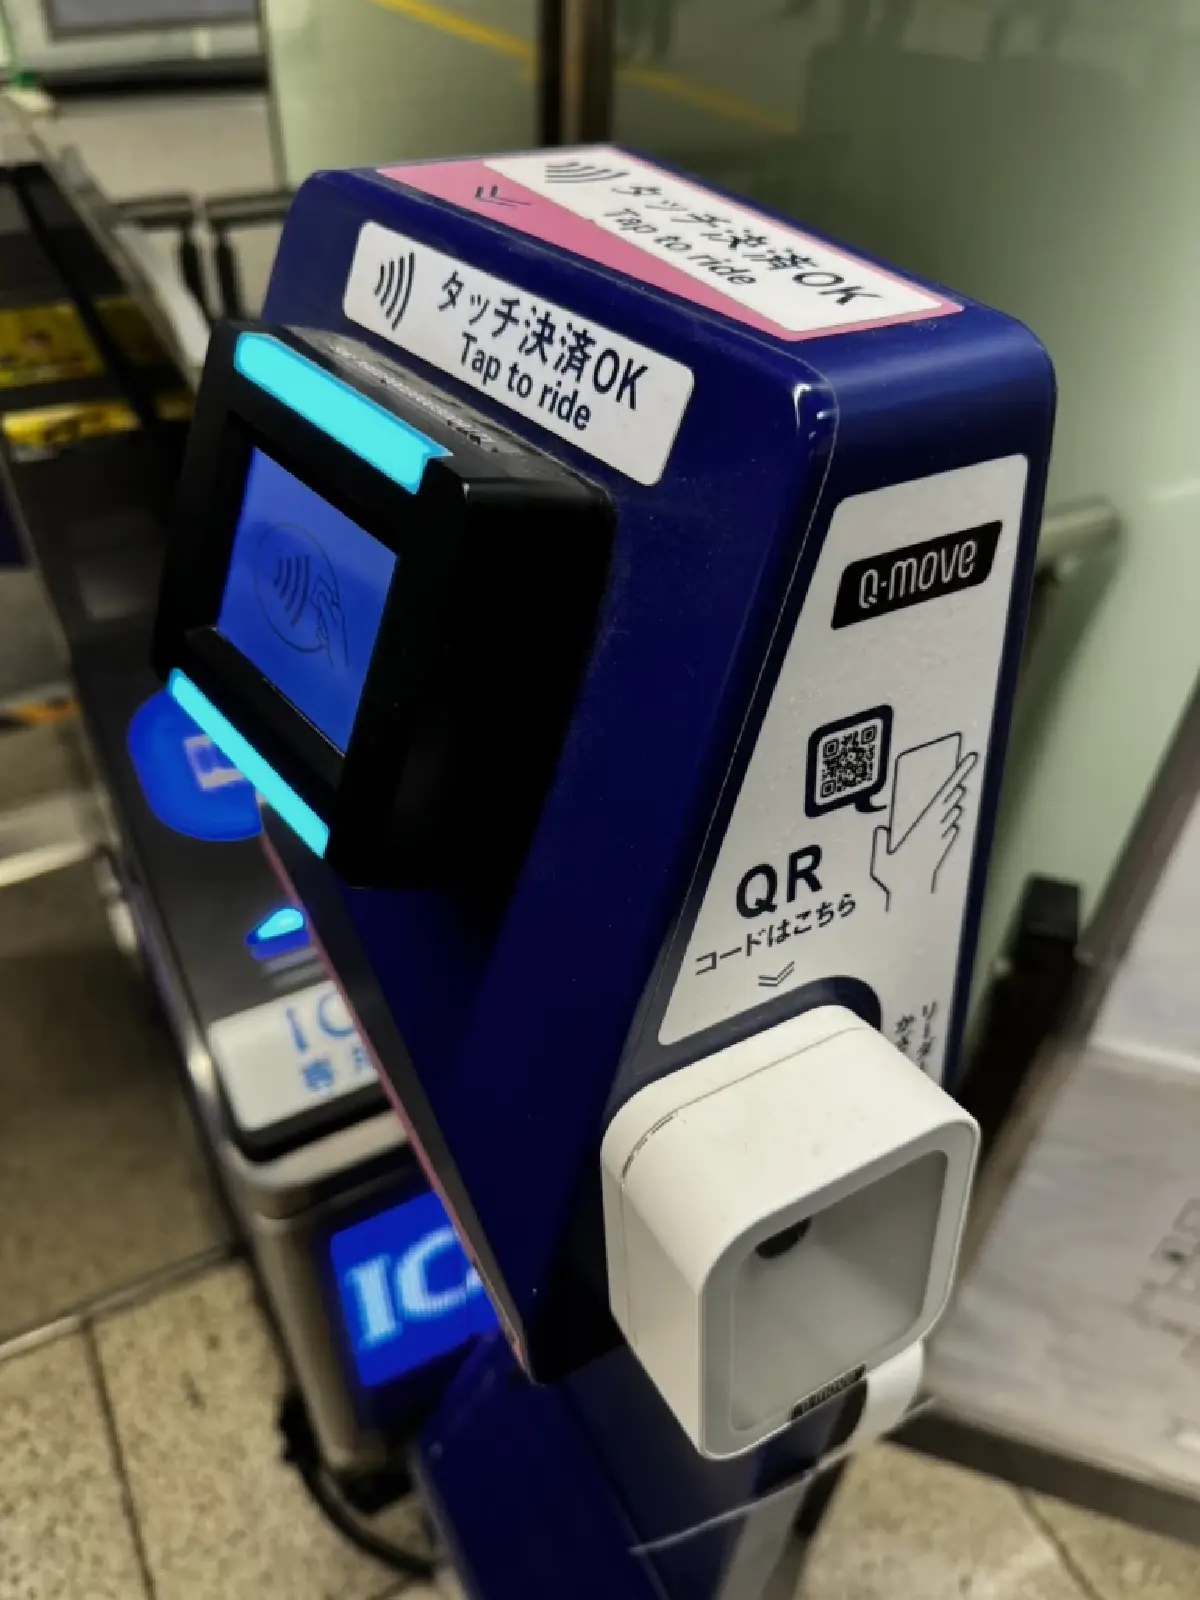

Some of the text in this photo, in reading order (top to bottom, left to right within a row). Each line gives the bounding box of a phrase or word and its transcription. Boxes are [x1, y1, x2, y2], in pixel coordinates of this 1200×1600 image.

[604, 207, 756, 285] Tap to ride
[438, 270, 648, 411] タッチ決済OK
[461, 331, 592, 431] Tap to ride
[735, 844, 823, 918] QR
[695, 893, 856, 976] コードはこちら
